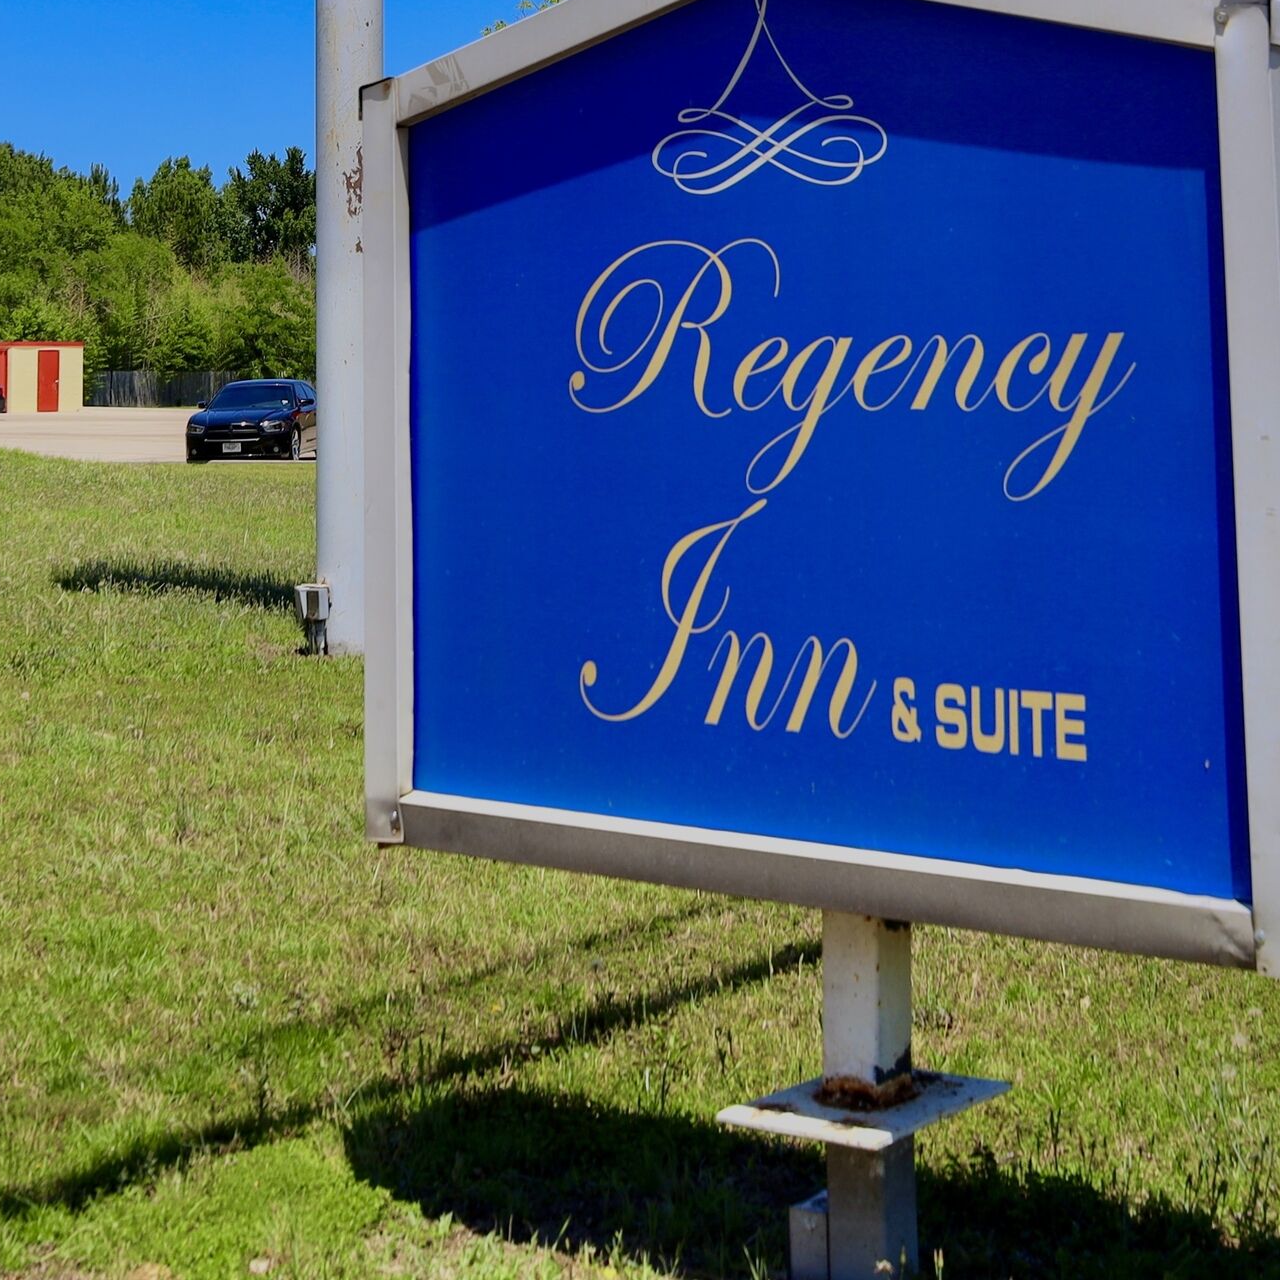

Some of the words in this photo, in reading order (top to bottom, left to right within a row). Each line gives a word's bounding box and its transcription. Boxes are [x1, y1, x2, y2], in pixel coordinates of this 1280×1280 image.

[568, 237, 1135, 501] Regency
[578, 498, 874, 740] Inn
[891, 677, 922, 743] &
[935, 683, 1087, 762] SUITE
